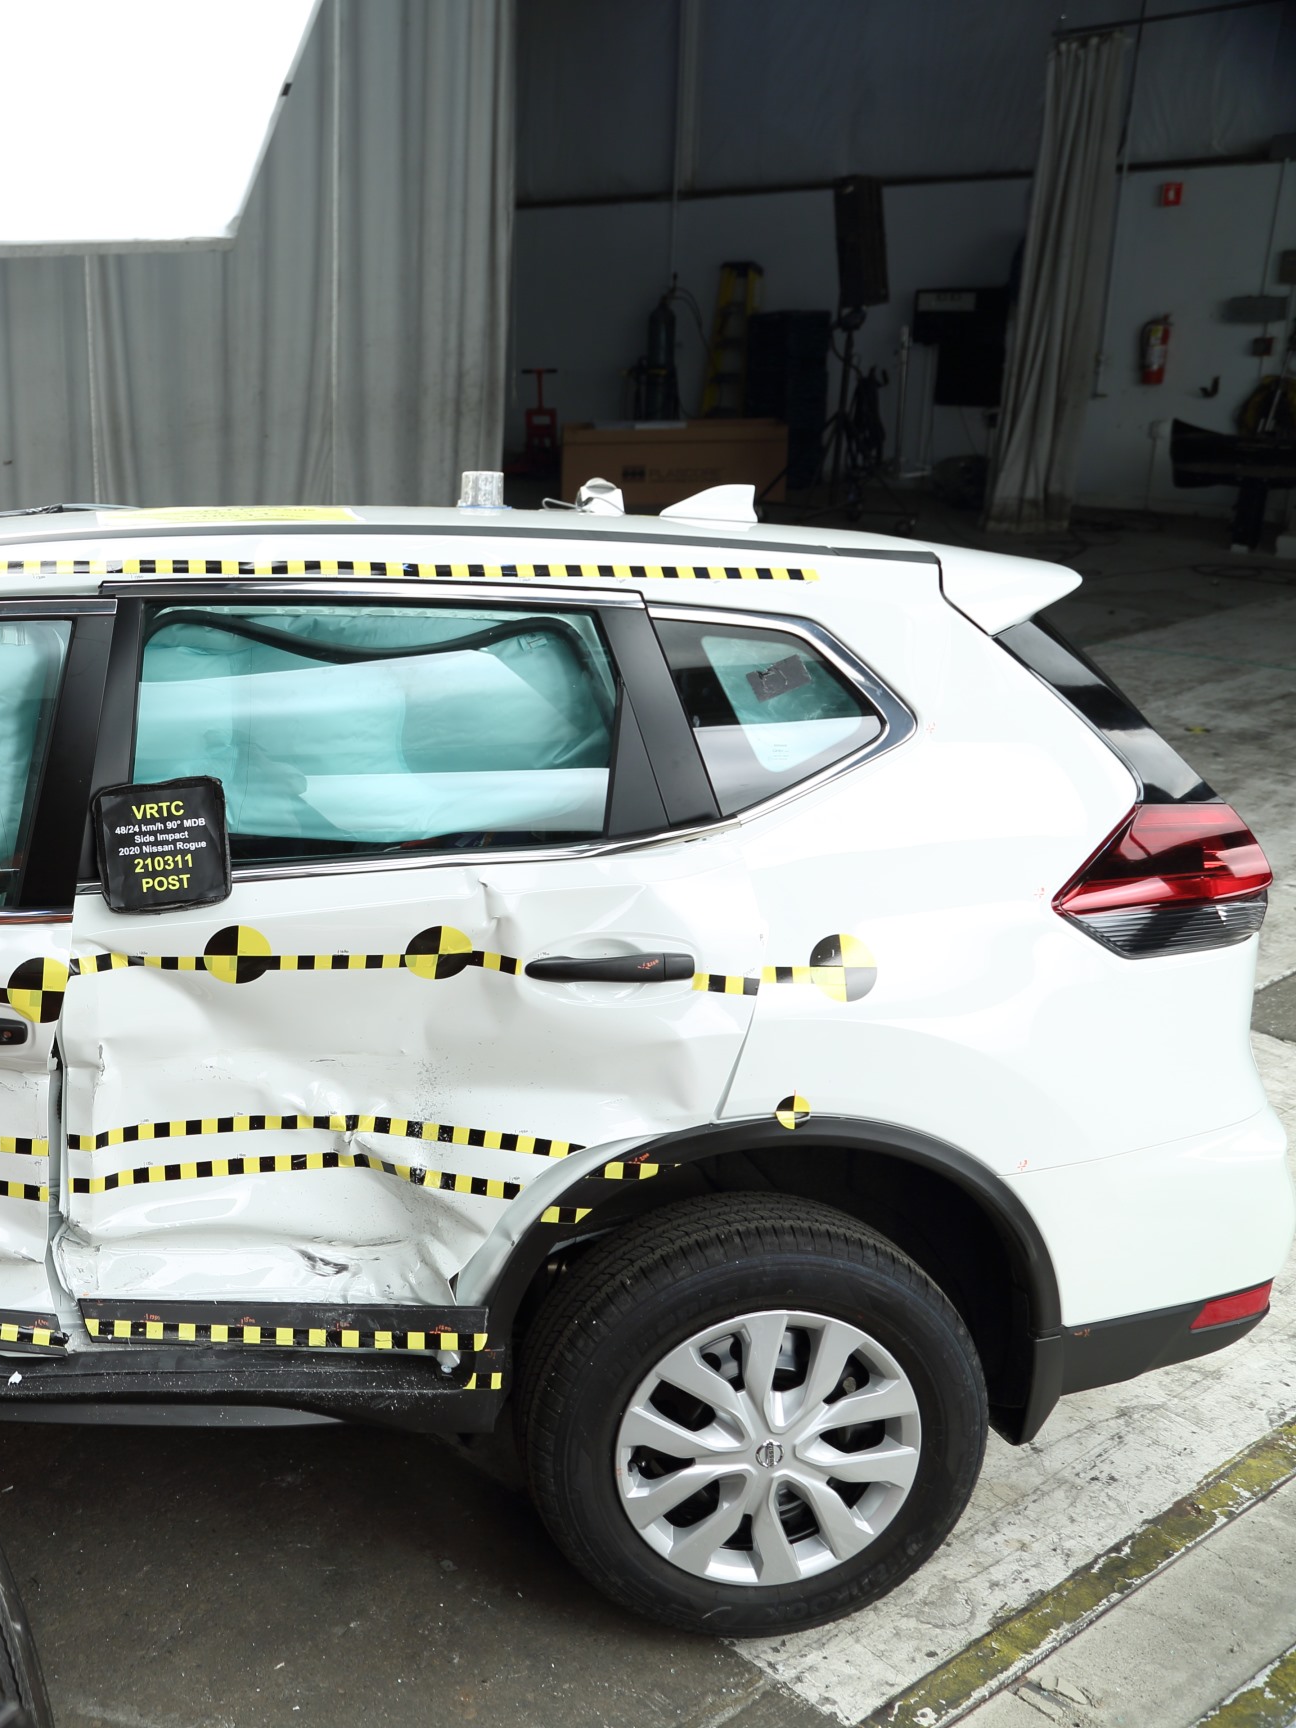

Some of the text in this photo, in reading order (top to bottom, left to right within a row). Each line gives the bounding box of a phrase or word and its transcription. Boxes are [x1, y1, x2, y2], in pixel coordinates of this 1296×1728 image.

[132, 801, 184, 820] VRTC
[115, 818, 206, 835] 48/24 km/h 90° MDB
[134, 831, 189, 844] Side Impact
[118, 840, 207, 856] 2020 Nissan Rogue
[134, 853, 193, 873] 210311
[142, 874, 191, 893] POST
